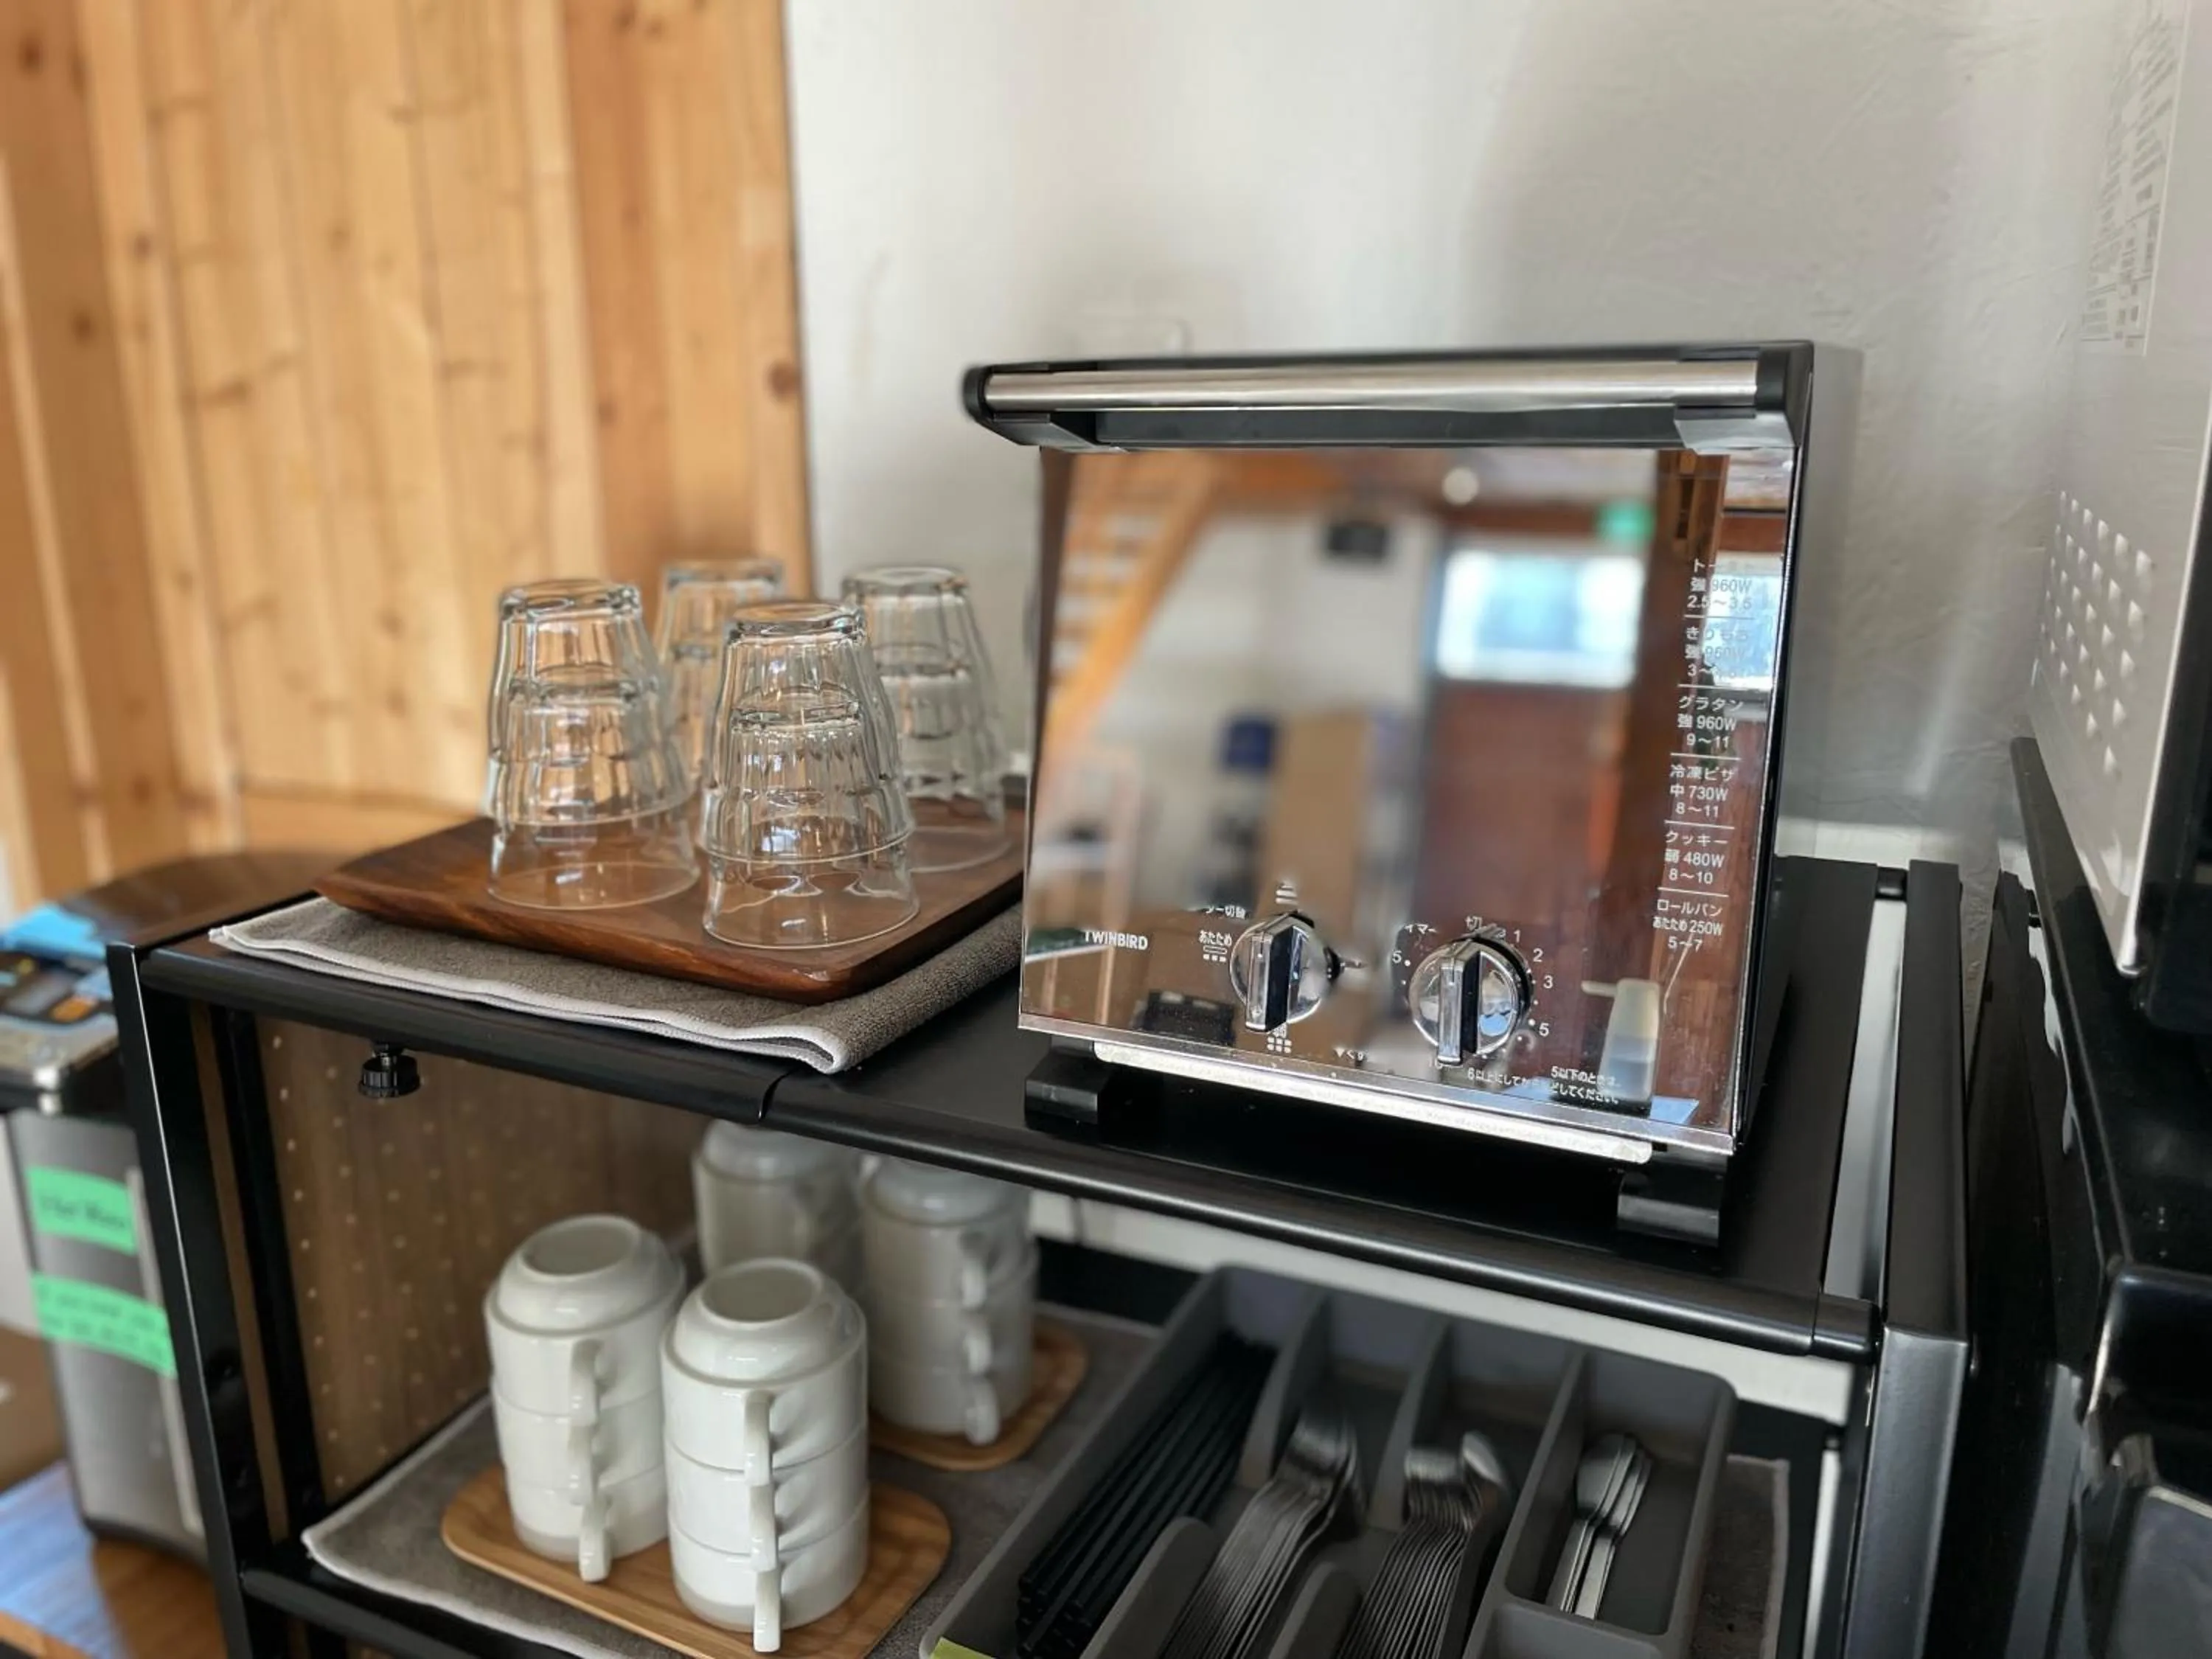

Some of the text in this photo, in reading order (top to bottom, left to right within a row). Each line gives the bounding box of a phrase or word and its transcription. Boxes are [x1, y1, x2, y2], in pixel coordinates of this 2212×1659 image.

[1679, 695, 1744, 712] グラタン
[1697, 714, 1736, 731] 960W
[1670, 783, 1728, 801] 中 730W
[1665, 830, 1728, 847] クッキー
[1683, 852, 1725, 868] 480W
[1657, 899, 1722, 917] ロールパン
[1514, 930, 1520, 942] 1
[1689, 919, 1723, 936] 250W
[1084, 931, 1148, 950] TWINBIRD
[1533, 948, 1543, 962] 2
[1543, 975, 1554, 989] 3
[1539, 1023, 1549, 1037] 5
